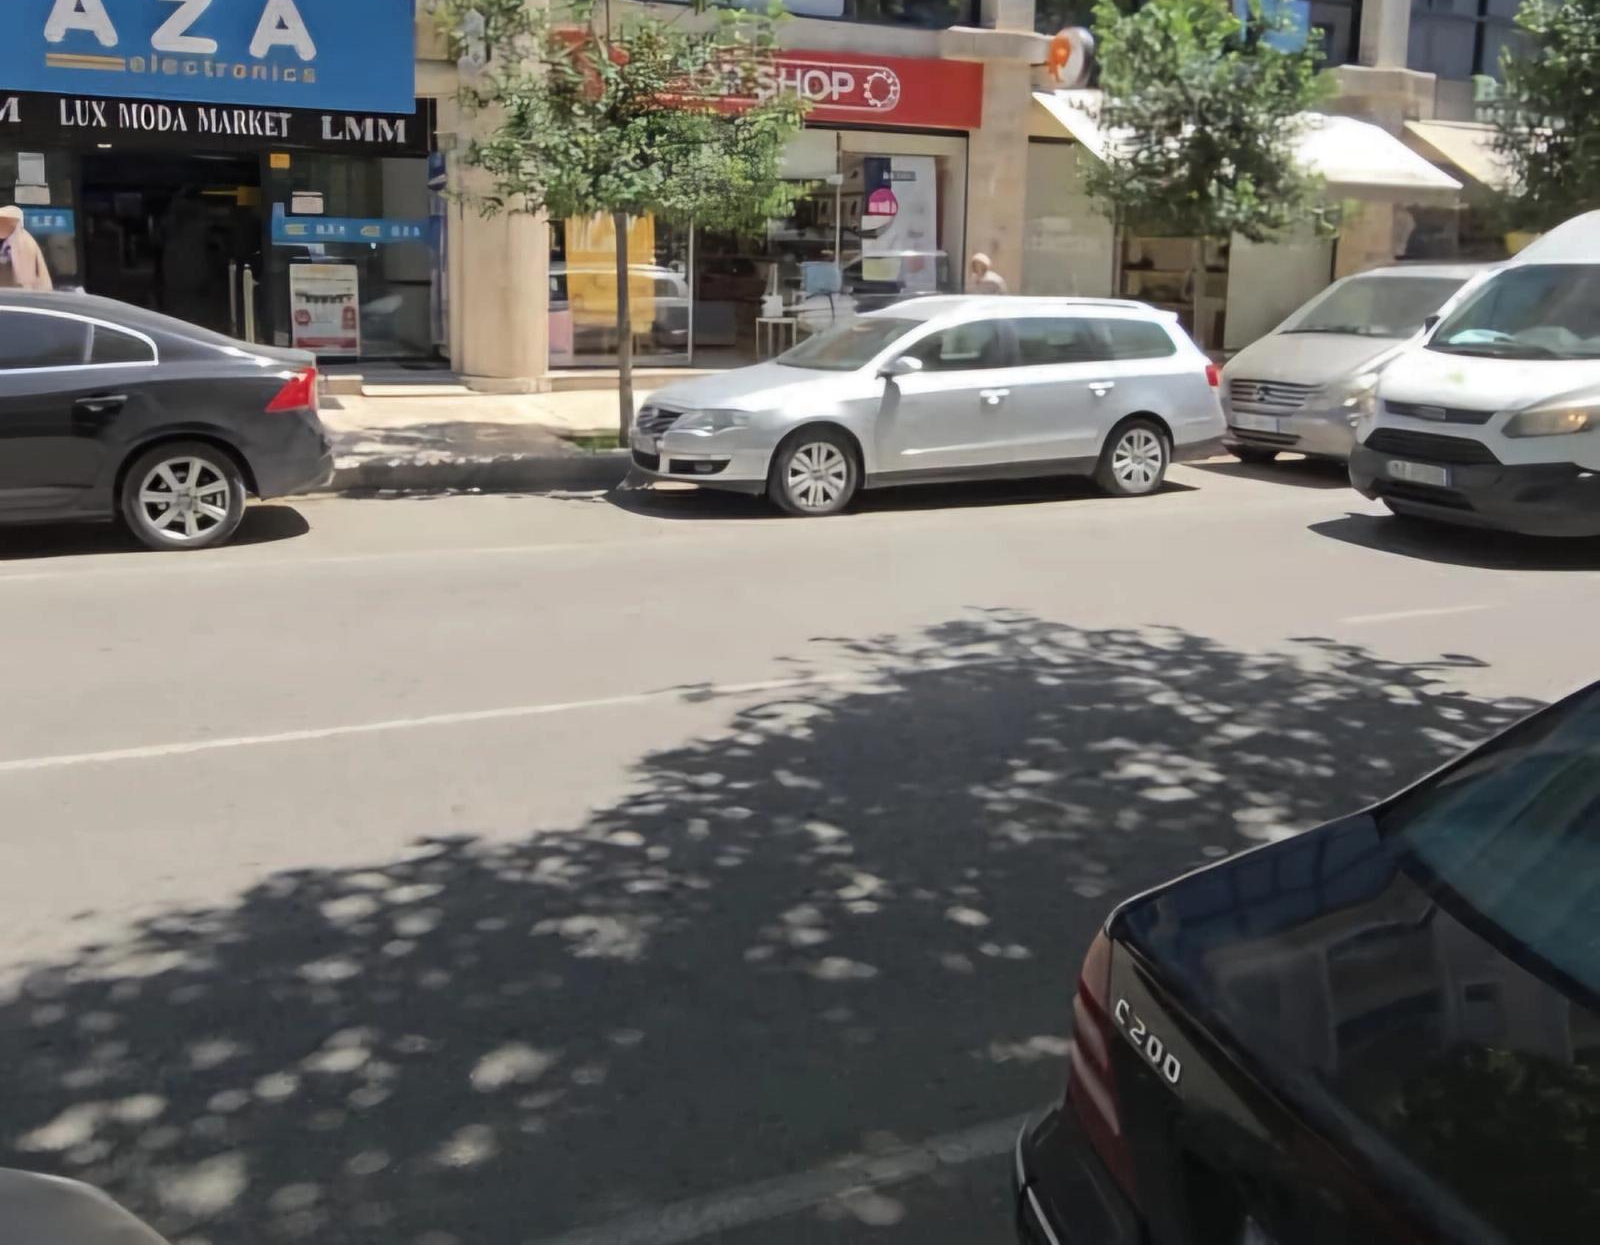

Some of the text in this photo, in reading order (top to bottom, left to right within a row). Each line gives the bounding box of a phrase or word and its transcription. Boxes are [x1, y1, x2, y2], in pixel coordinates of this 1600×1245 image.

[129, 54, 317, 84] electronics
[59, 98, 293, 138] LUX MODA MARKET
[320, 115, 406, 143] LMM
